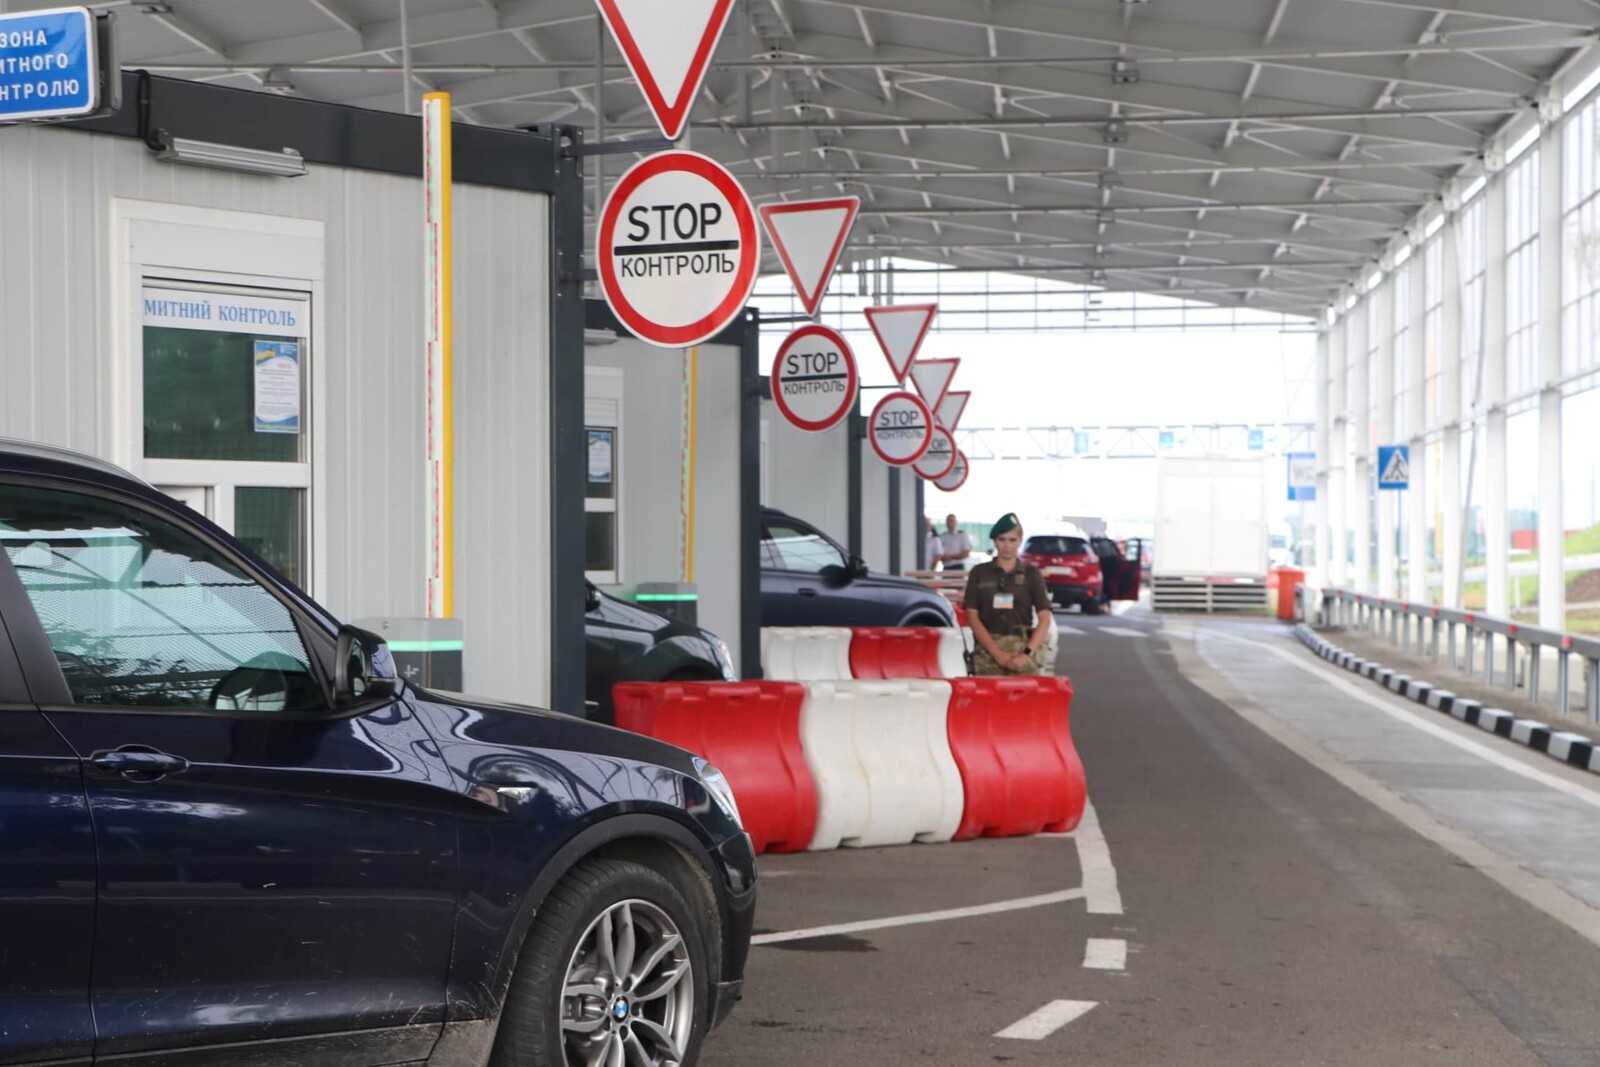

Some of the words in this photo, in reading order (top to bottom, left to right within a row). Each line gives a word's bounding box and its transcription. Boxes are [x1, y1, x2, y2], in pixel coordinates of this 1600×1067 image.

[0, 30, 47, 47] ЗОНА
[627, 203, 722, 241] STOP
[621, 253, 735, 278] КОНТРОЛЬ
[144, 299, 211, 320] МИТНИЙ
[218, 305, 296, 326] КОНТРОЛЬ
[787, 352, 839, 375] STOP
[783, 380, 846, 394] КОНТРОЛЬ
[881, 410, 919, 426] STOP
